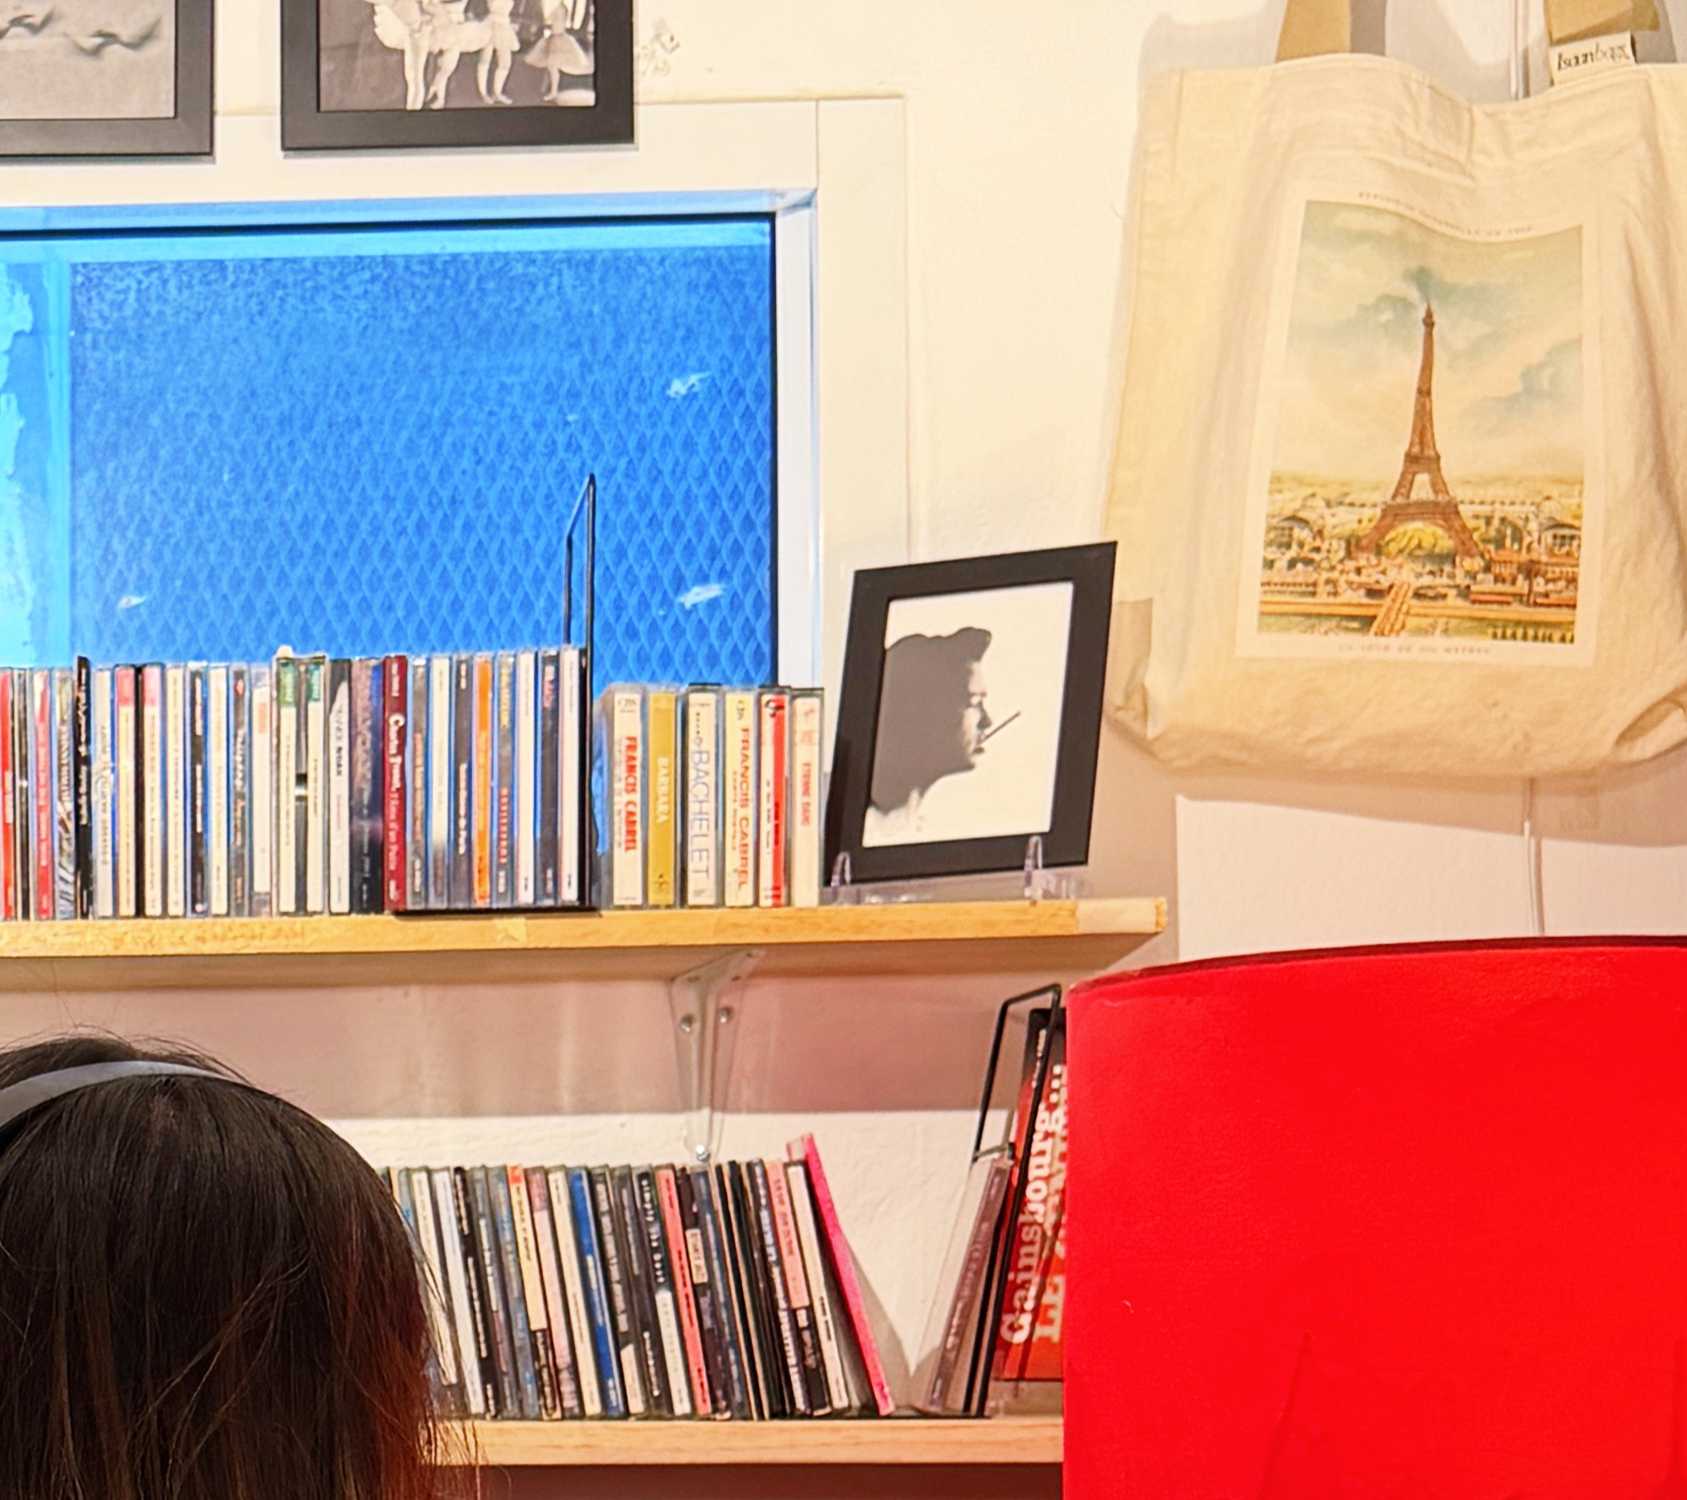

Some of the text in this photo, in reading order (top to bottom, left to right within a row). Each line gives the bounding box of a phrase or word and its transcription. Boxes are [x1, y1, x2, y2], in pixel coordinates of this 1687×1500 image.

[624, 736, 637, 853] FRANCIS CABREL
[656, 756, 668, 824] BARBARA
[690, 750, 711, 880] BACHELET
[737, 727, 751, 891] FRANCIS CABREL
